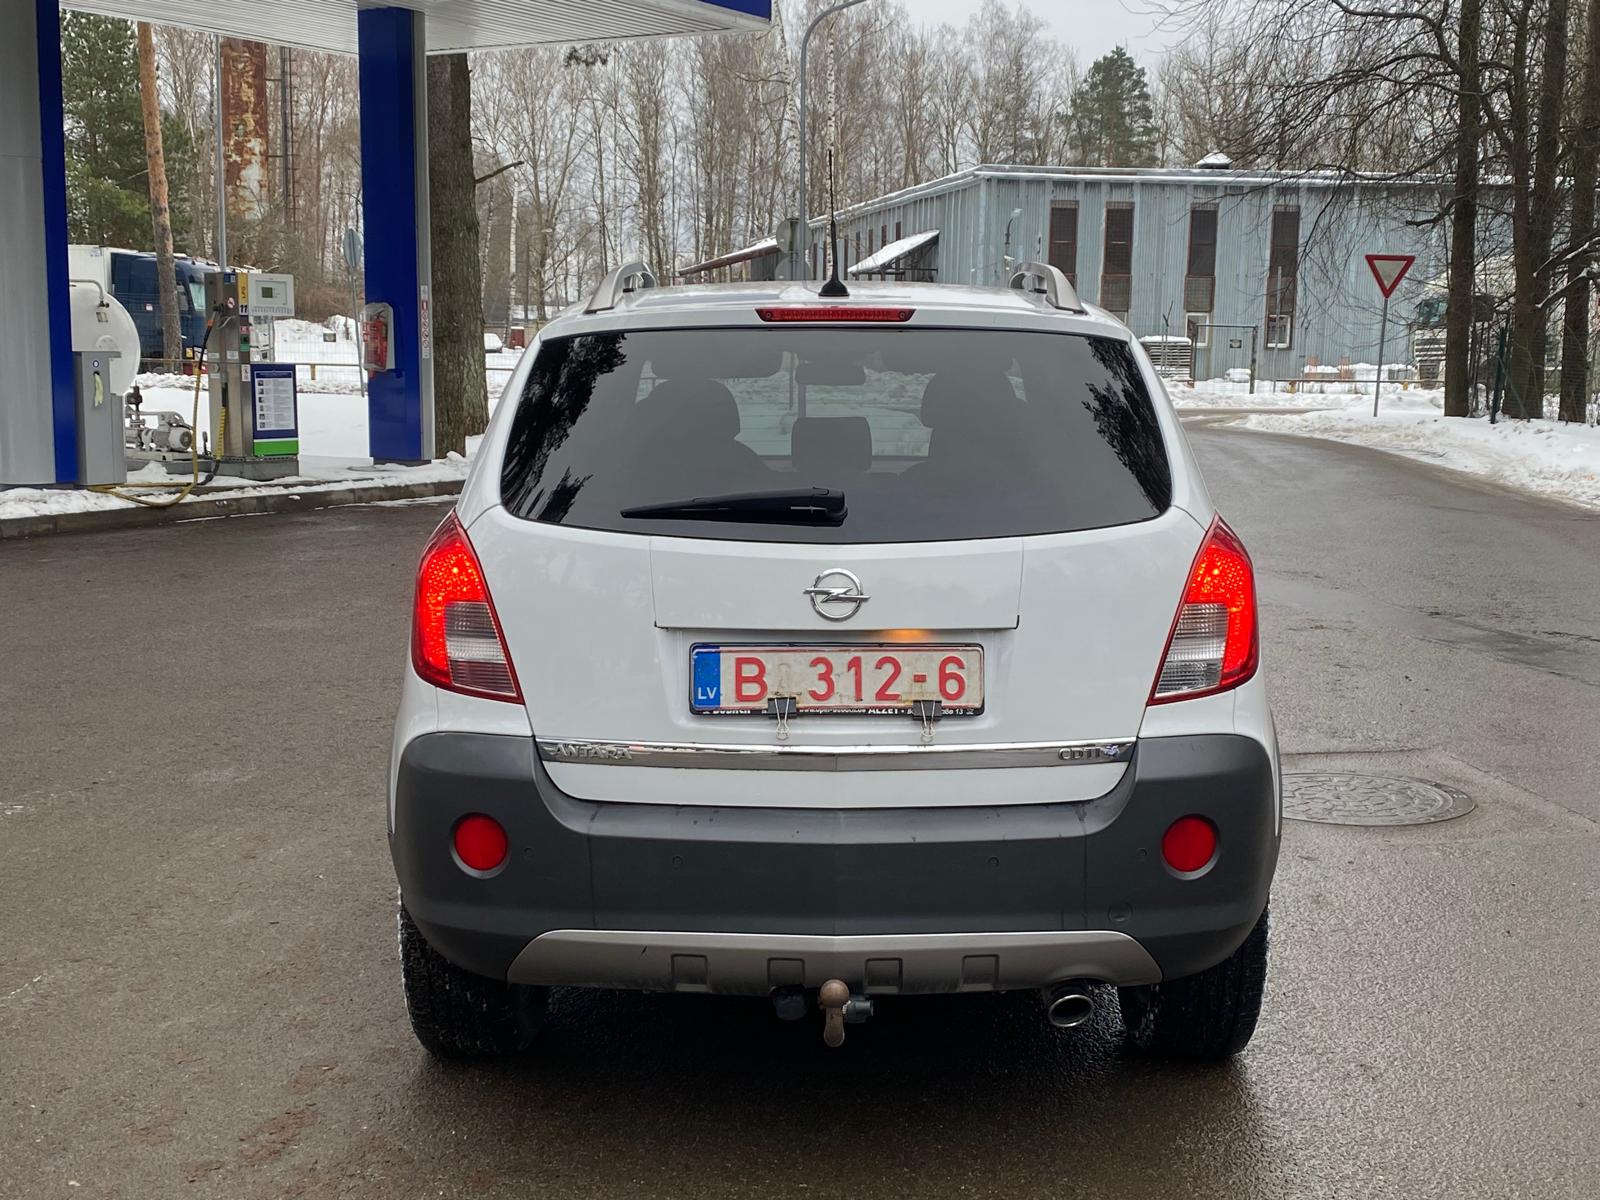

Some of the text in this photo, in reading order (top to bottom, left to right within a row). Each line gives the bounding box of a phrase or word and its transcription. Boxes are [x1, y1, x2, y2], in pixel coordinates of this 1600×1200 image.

[240, 304, 248, 313] 11
[735, 655, 966, 702] B 312-6
[697, 687, 717, 700] LV
[554, 743, 633, 760] ANTARA
[1058, 746, 1103, 760] CDTI
